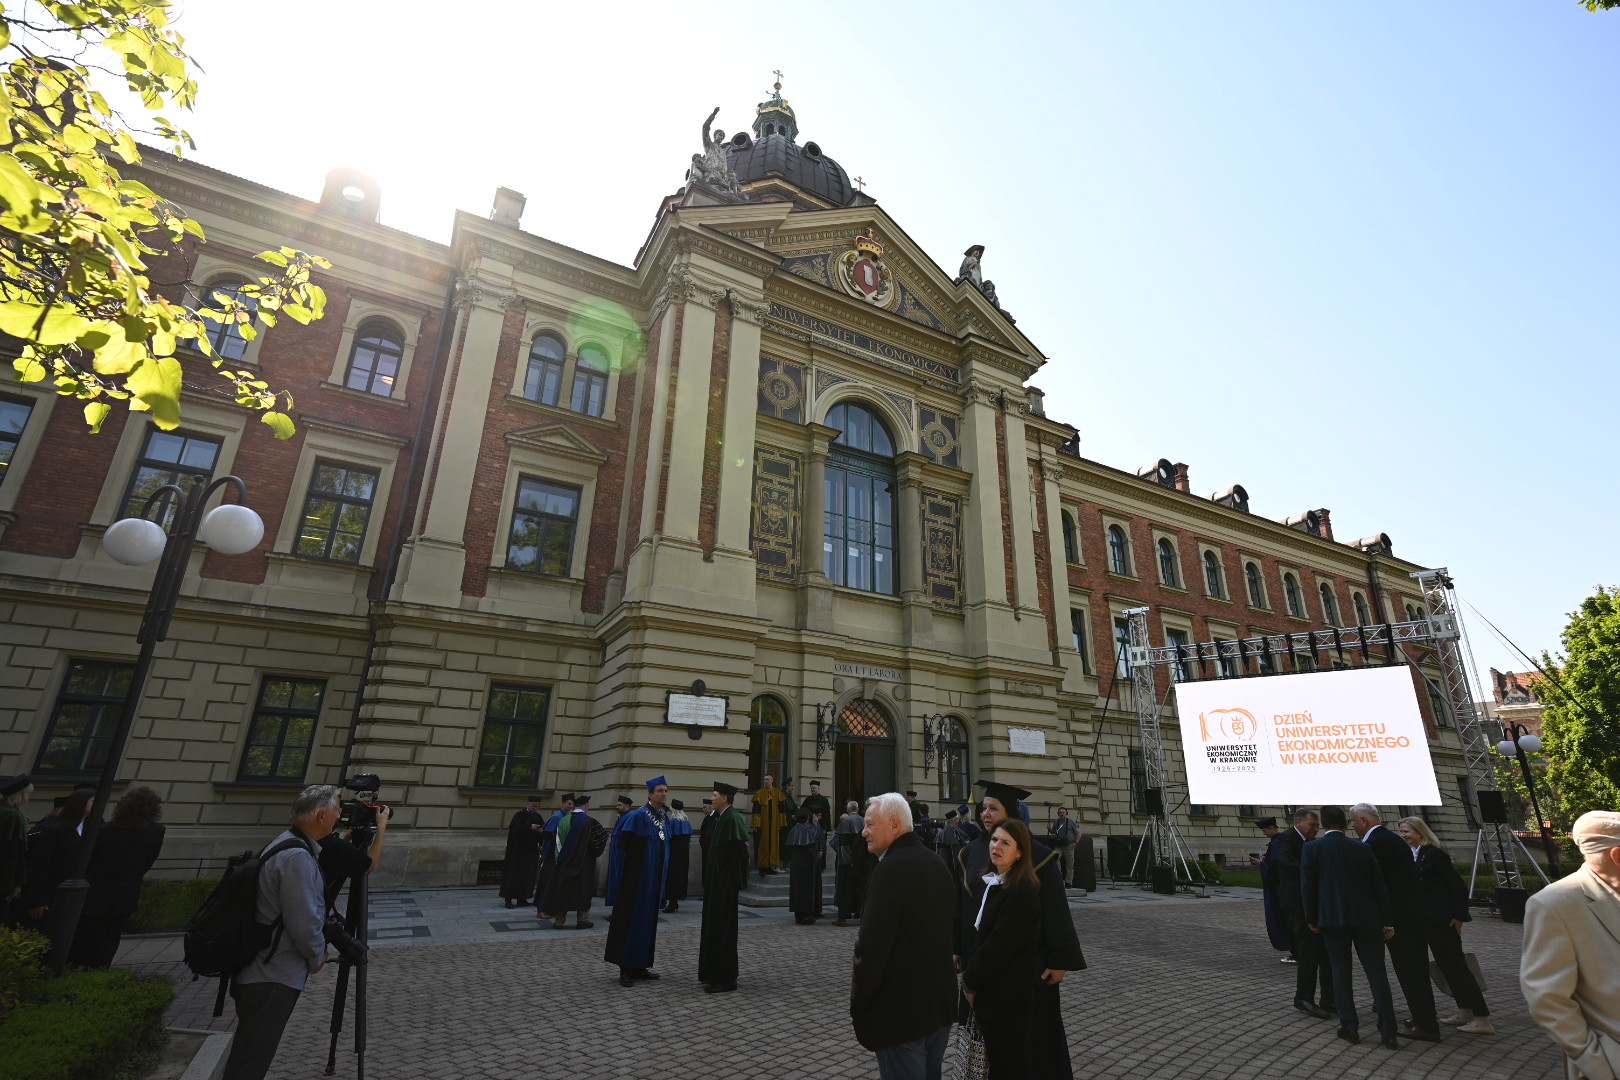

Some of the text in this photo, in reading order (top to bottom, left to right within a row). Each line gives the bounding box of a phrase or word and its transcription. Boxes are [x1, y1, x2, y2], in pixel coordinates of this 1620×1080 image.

[869, 340, 955, 379] EKONOMICZNY
[834, 663, 903, 680] ORA ET LABORA
[1273, 710, 1313, 726] DZIEŃ
[1275, 723, 1386, 738] UNIWERSYTETU
[1206, 744, 1257, 752] UNIWERSYTET
[1277, 736, 1410, 752] EKONOMICZNEGO
[1206, 750, 1258, 758] EKONOMICZNY
[1279, 751, 1379, 765] W KRAKOWIE
